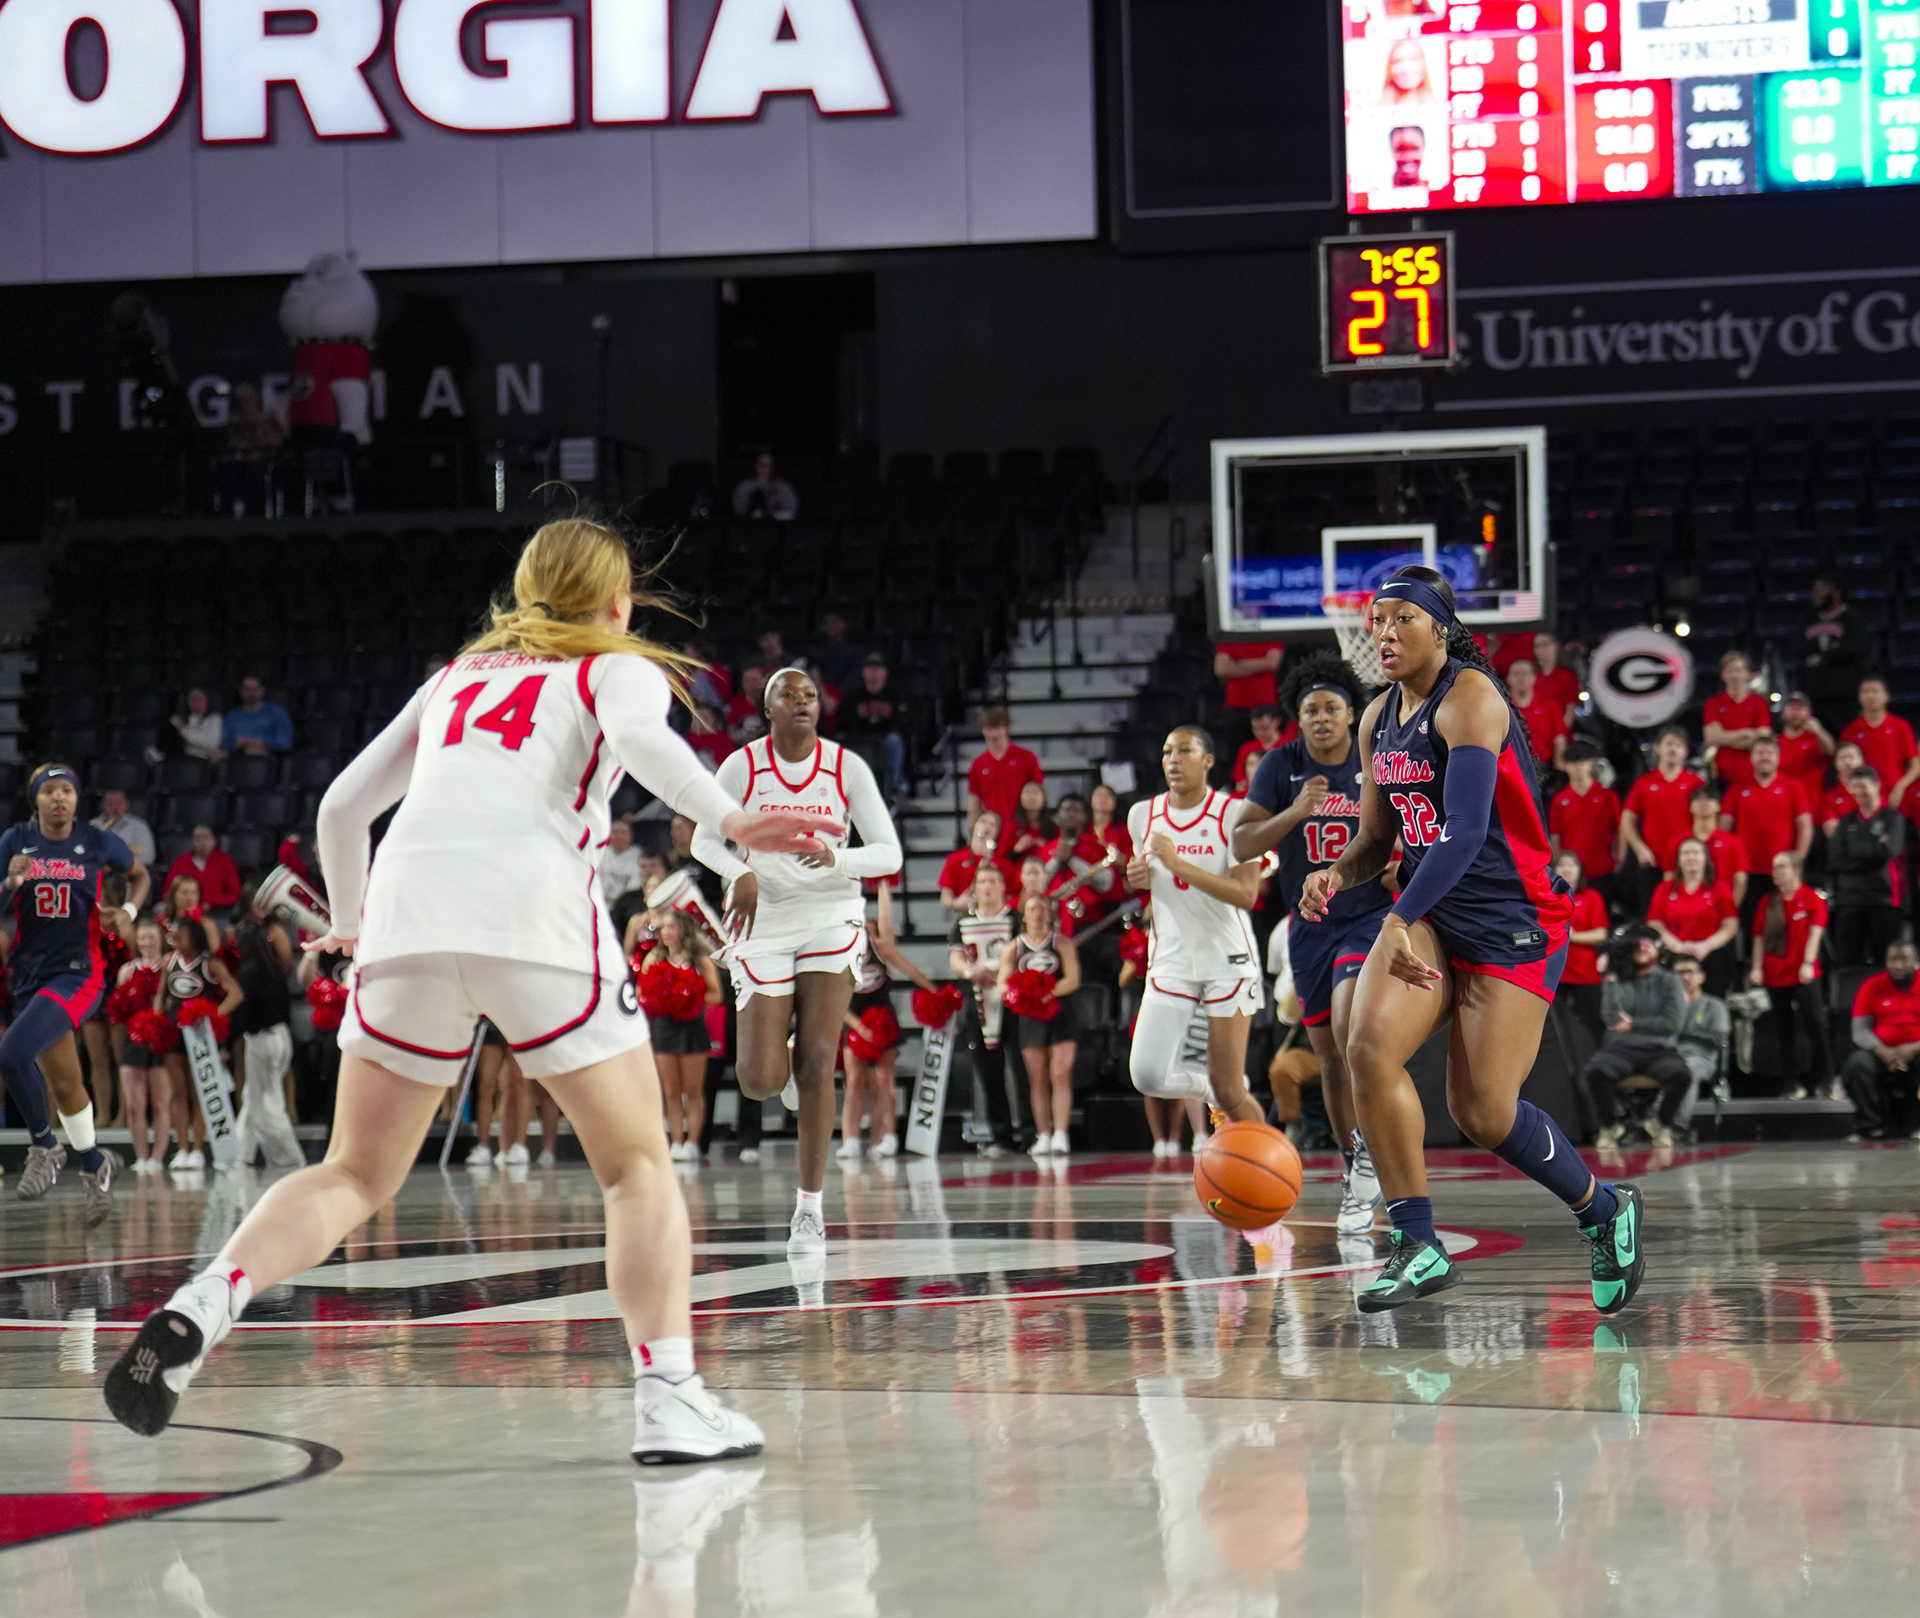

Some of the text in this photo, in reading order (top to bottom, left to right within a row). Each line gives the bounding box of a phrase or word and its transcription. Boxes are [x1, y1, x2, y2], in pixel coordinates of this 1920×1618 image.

[1588, 41, 1604, 71] 1
[1647, 36, 1790, 61] TURNOVERS
[0, 0, 897, 156] ORGIA
[1360, 246, 1441, 286] 7:55
[1348, 287, 1431, 355] 27
[1474, 289, 1920, 379] University of G
[441, 674, 549, 751] 14
[1372, 751, 1435, 785] Ole Miss
[1389, 792, 1441, 846] 32
[1176, 845, 1215, 855] RGIA
[1303, 821, 1351, 864] 12
[46, 858, 86, 880] Miss
[34, 882, 71, 918] 21
